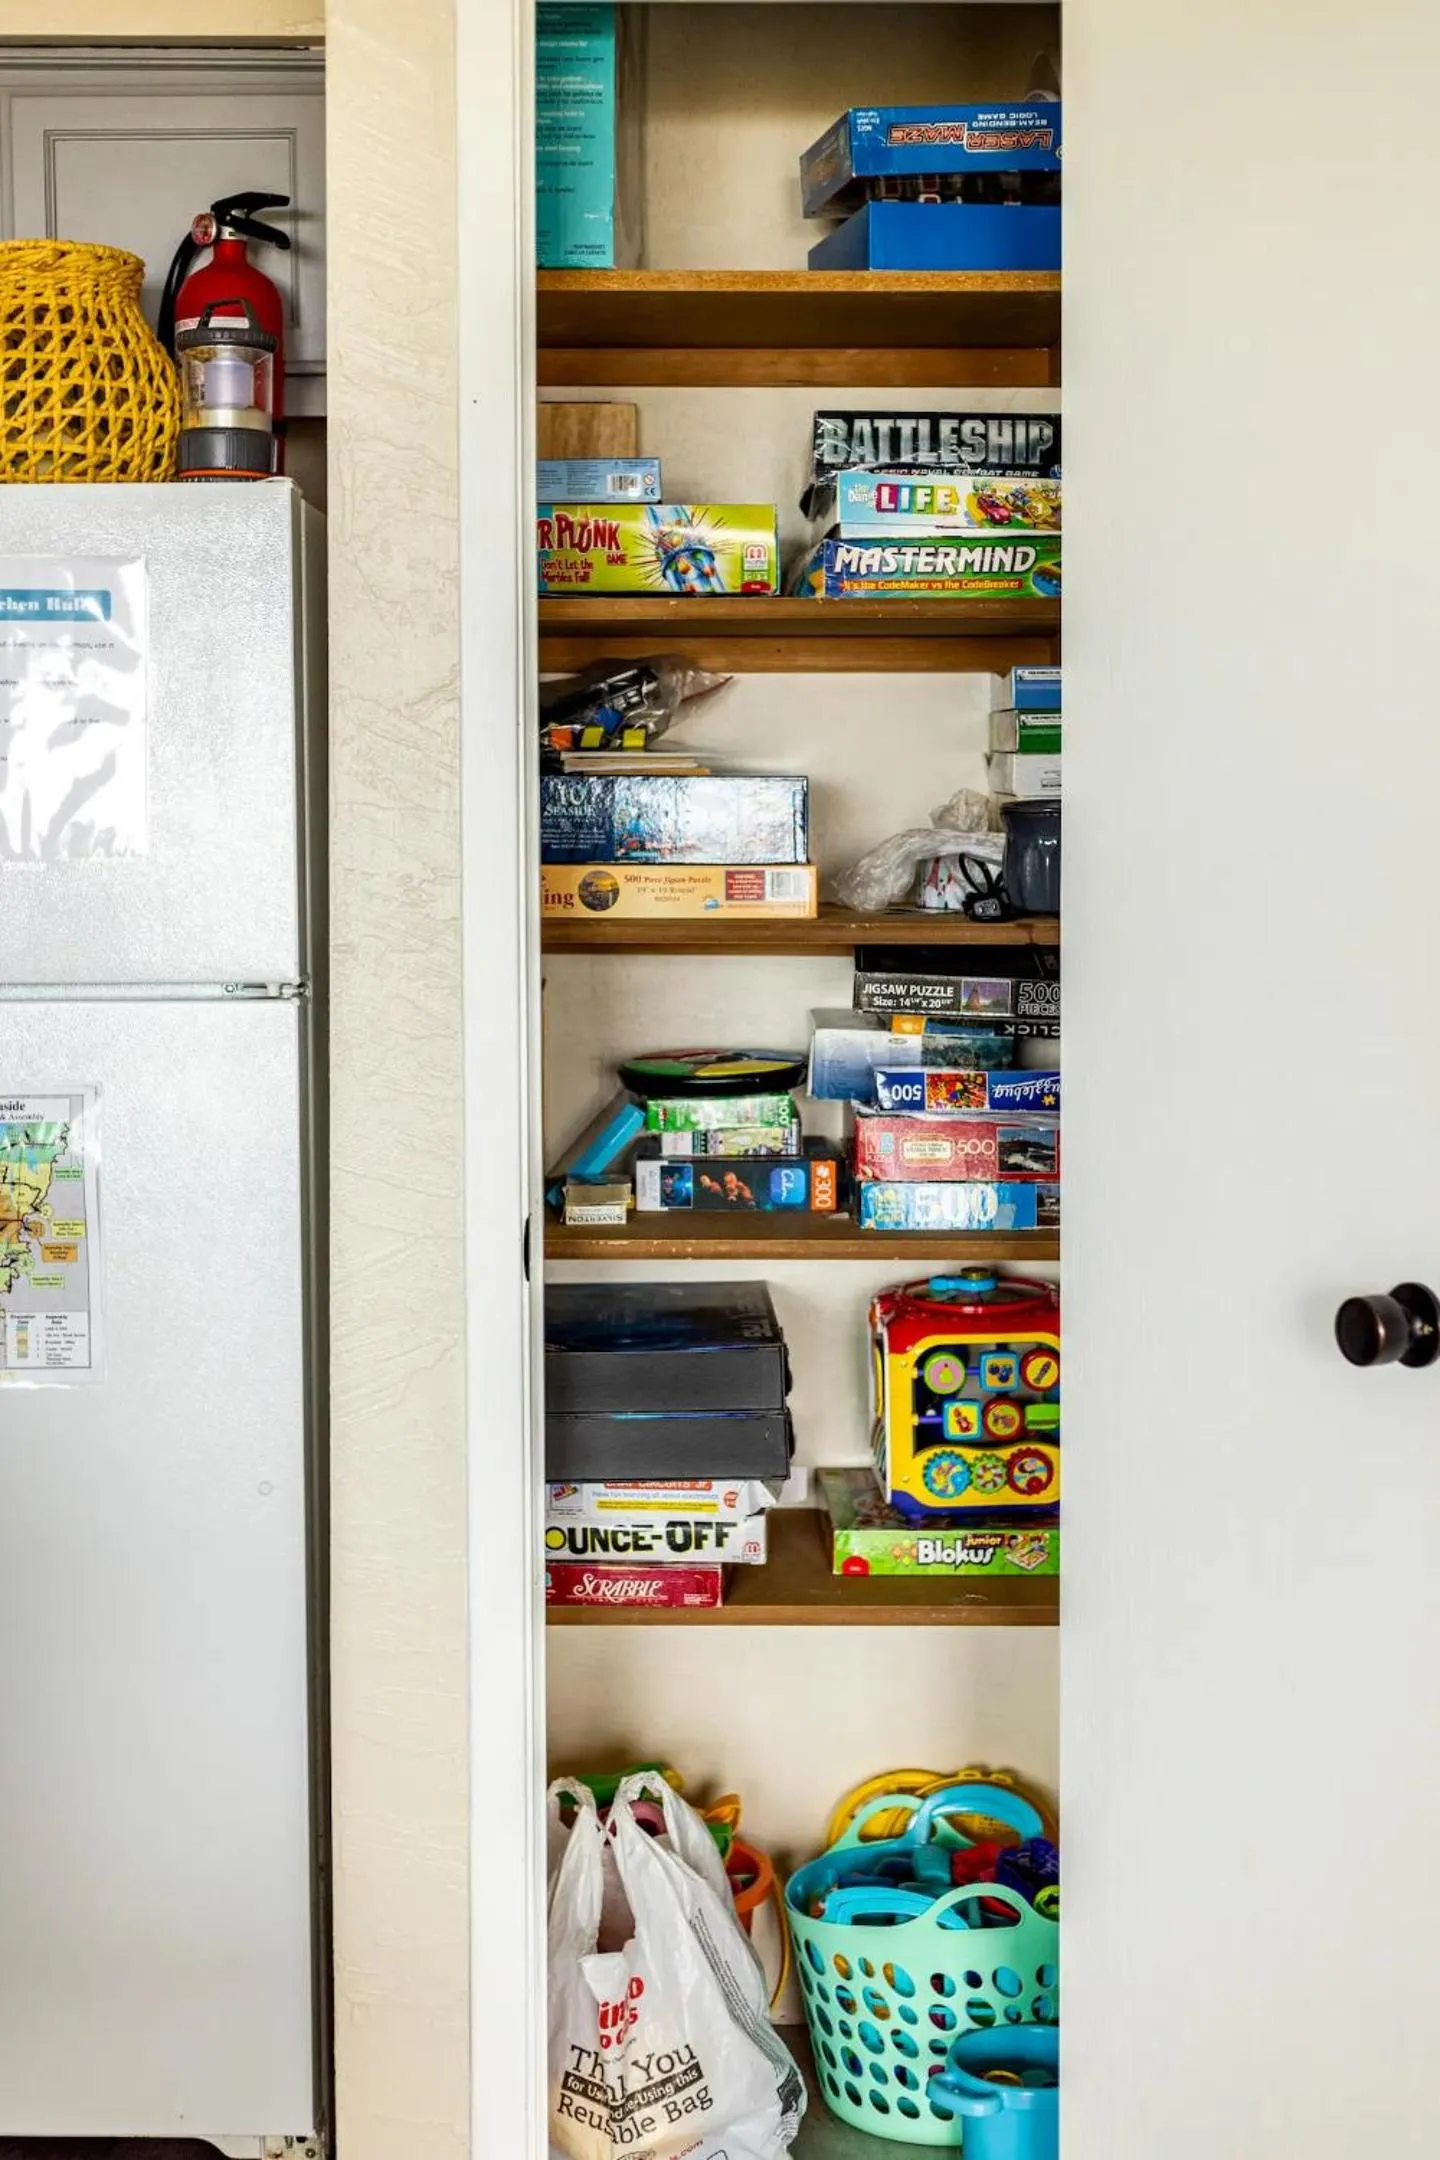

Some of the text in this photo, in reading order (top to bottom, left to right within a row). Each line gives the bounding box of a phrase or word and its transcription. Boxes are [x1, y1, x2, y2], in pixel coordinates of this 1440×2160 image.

[972, 119, 1048, 128] BEAM-BENDING
[977, 112, 1038, 121] LOGIC GAME
[888, 124, 1053, 151] LASER MAZE
[822, 418, 1053, 465] BATTLESHIP
[881, 486, 952, 512] LIFE
[834, 547, 1036, 575] MASTERMIND
[863, 983, 954, 997] JIGSAW PUZZLE
[873, 997, 896, 1006] Size:
[1018, 983, 1060, 1002] 500
[892, 1084, 922, 1100] 500
[957, 1139, 995, 1155] 500
[815, 1177, 832, 1208] 300
[965, 1534, 1002, 1547] junior
[917, 1538, 994, 1569] Blokus
[572, 1573, 664, 1602] SCRABBLE
[632, 2044, 697, 2083] You
[567, 2075, 585, 2093] for
[676, 2068, 699, 2089] this
[662, 2085, 714, 2124] Bag
